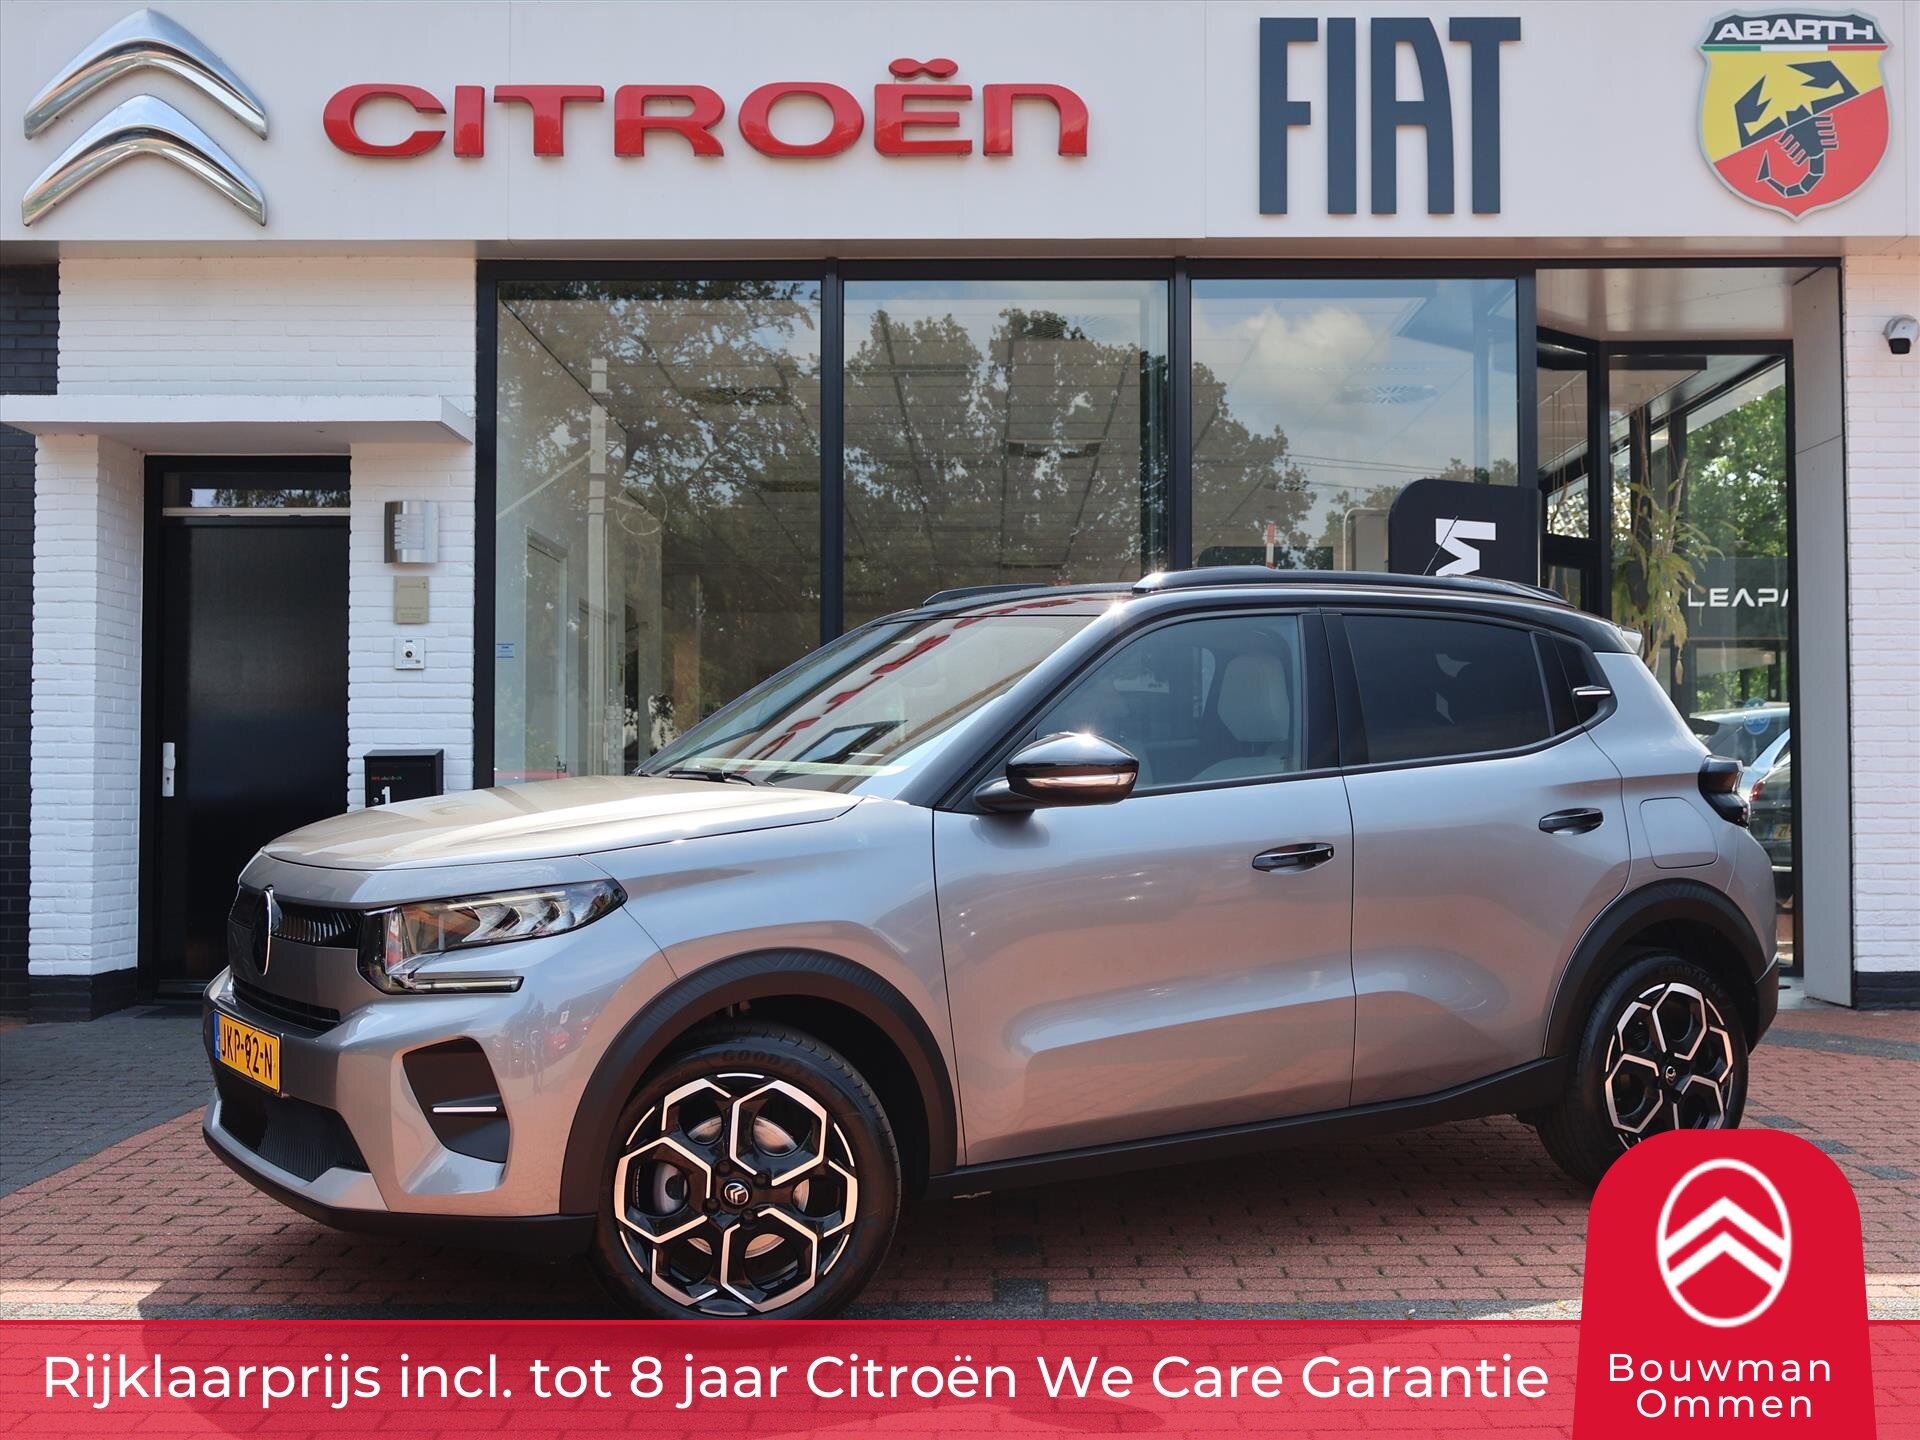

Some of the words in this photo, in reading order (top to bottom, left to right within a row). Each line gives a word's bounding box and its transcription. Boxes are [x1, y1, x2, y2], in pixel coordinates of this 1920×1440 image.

[1715, 19, 1874, 41] ABARTH
[323, 58, 1089, 157] CITROËN
[1259, 17, 1521, 215] FIAT
[221, 1023, 273, 1080] JKP-92-N
